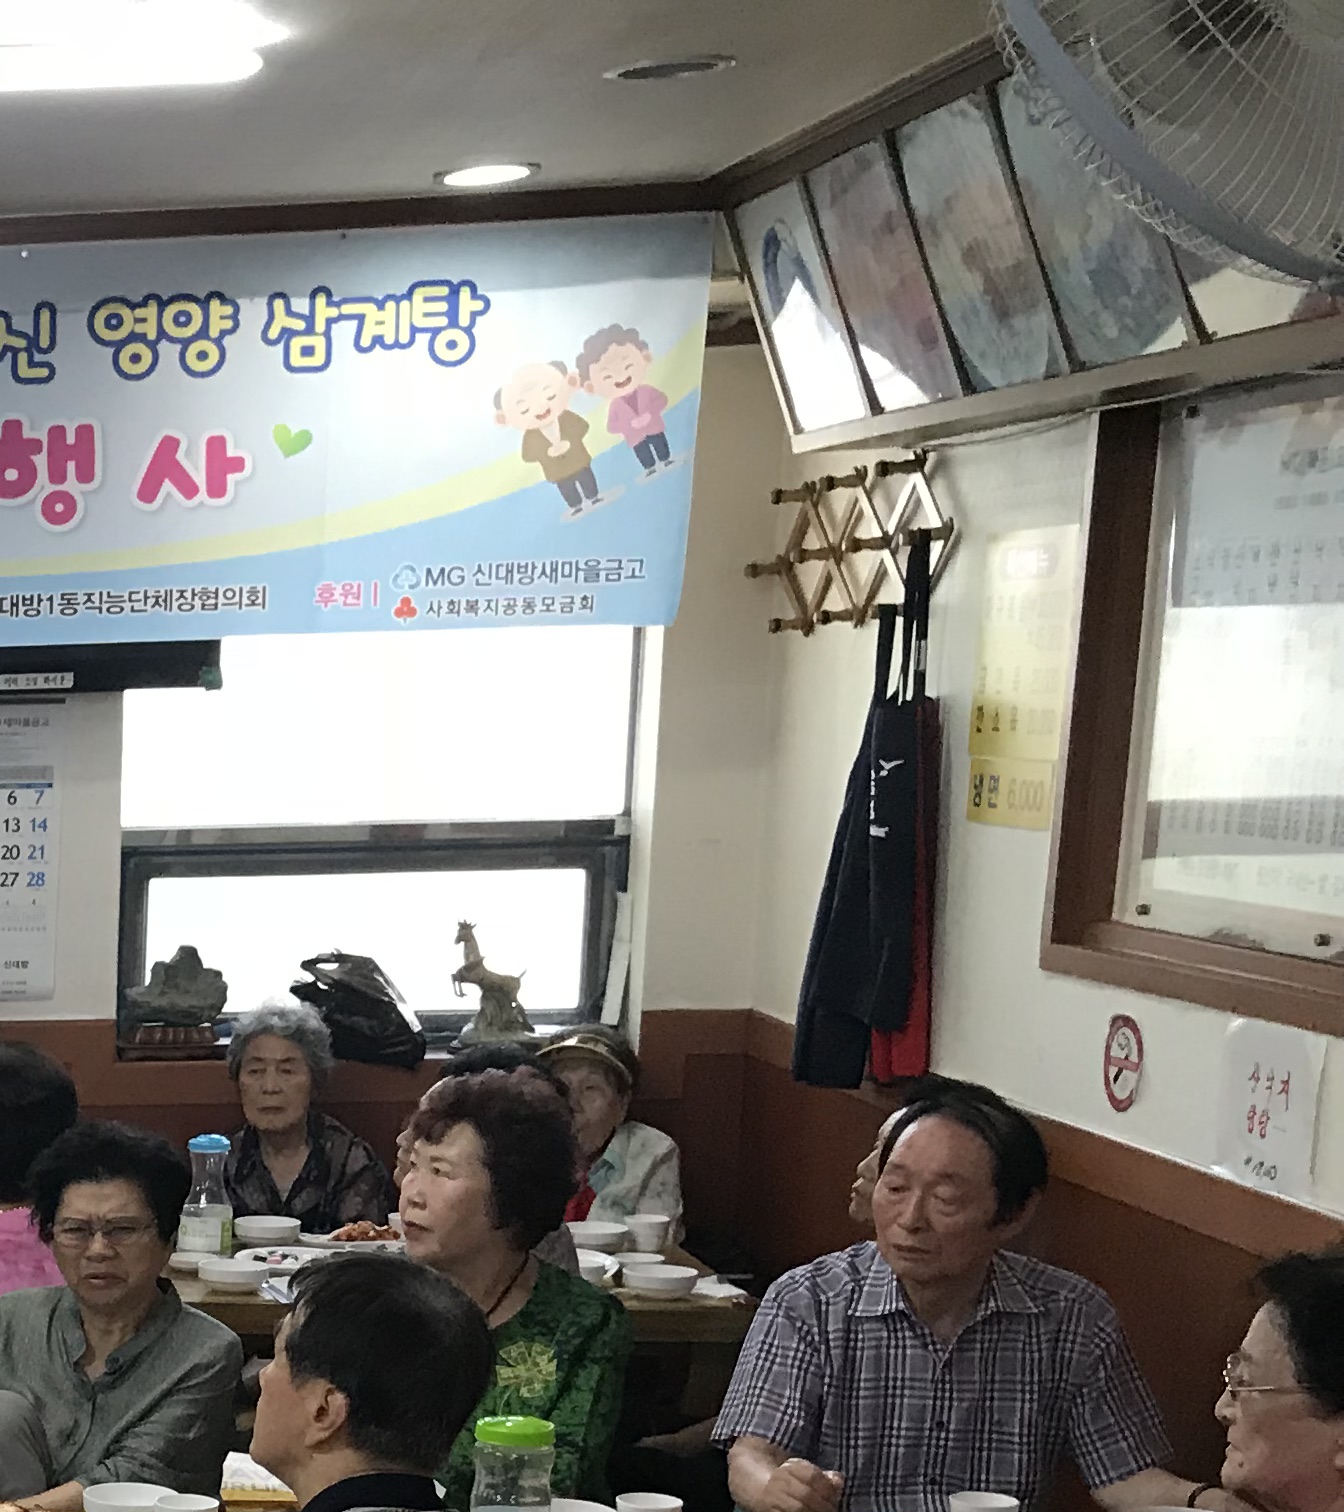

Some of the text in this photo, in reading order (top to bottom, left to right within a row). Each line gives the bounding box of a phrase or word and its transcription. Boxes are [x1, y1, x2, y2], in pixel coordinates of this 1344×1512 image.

[87, 291, 240, 381] 영양
[262, 279, 490, 374] 삼계탕
[315, 557, 646, 608] 후원 MG 신대방새마을금고
[425, 594, 595, 619] 사회복지공동모금회
[7, 791, 17, 805] 6
[35, 790, 44, 805] 7
[973, 773, 1000, 809] 냉면
[3, 817, 21, 832] 13
[30, 818, 48, 832] 14
[1, 845, 20, 860] 20
[28, 844, 44, 860] 21
[0, 872, 19, 887] 27
[26, 872, 45, 887] 28
[3, 960, 29, 970] 신대방
